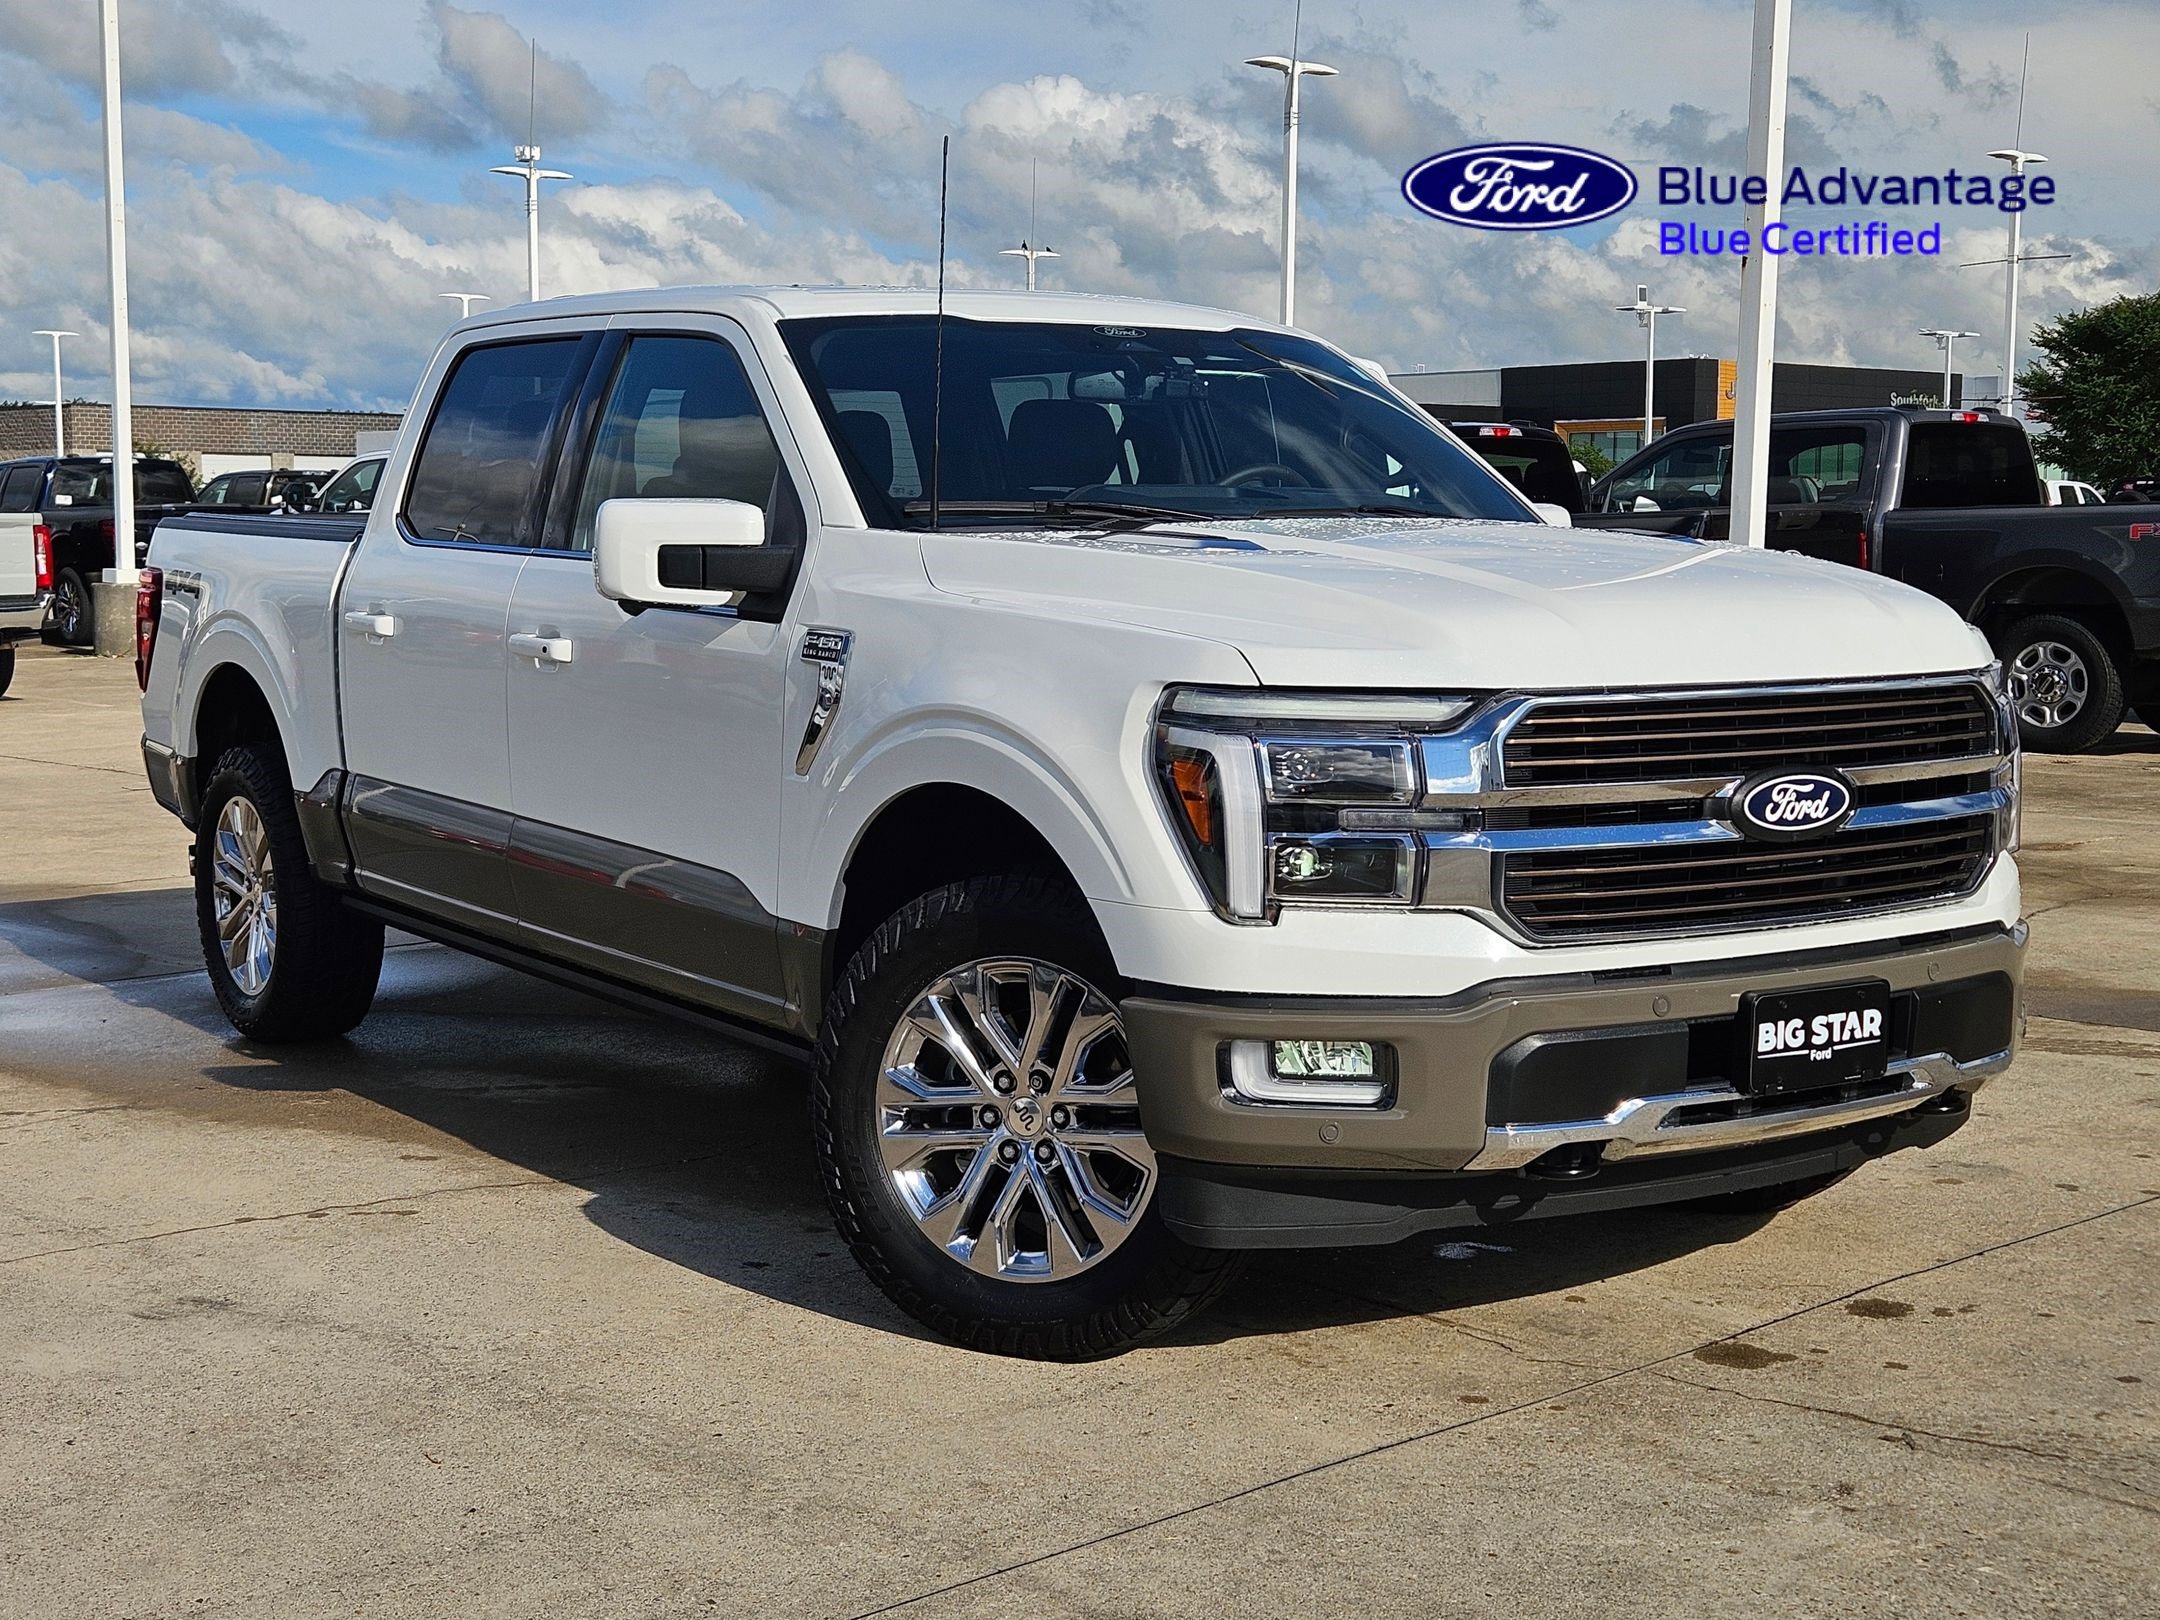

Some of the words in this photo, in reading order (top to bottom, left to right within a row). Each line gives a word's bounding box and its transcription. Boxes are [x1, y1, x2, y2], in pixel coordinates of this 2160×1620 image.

[1765, 783, 1831, 822] Ford
[1757, 1018, 1805, 1053] BIG
[1811, 1008, 1882, 1046] STAR
[1810, 1047, 1832, 1061] Ford
